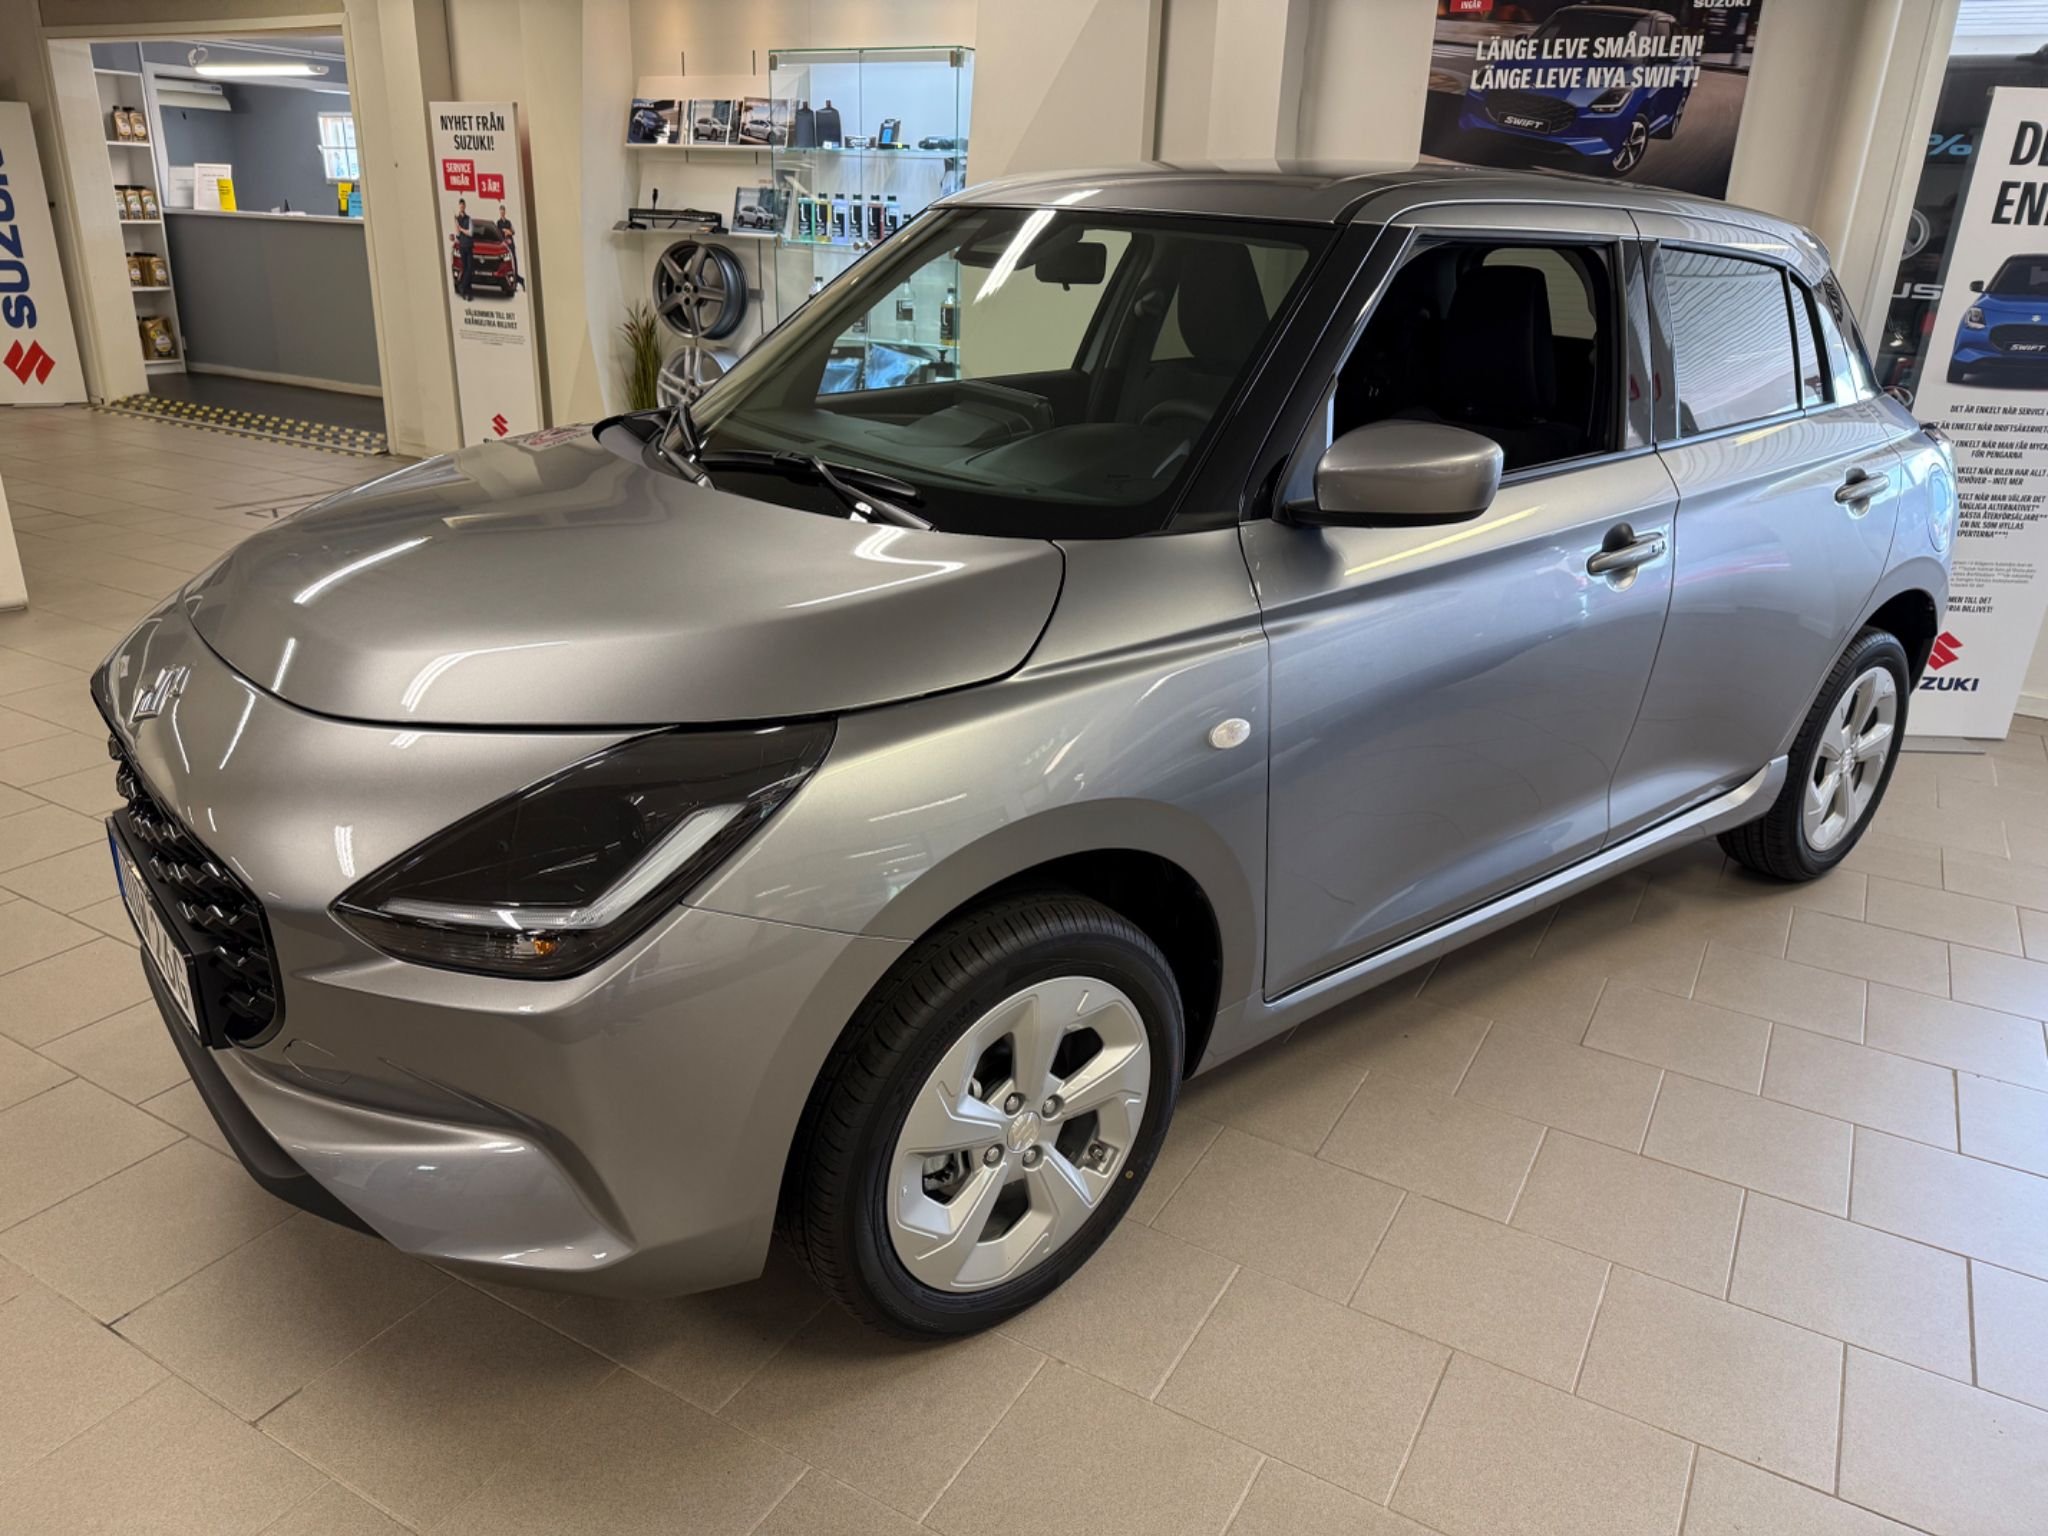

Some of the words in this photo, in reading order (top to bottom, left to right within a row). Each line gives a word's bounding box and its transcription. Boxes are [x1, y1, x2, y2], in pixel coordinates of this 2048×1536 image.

[1476, 36, 1538, 61] LÄNGE
[1542, 37, 1590, 60] LEVE
[1593, 31, 1704, 59] SMÅBILEN!
[1470, 65, 1533, 90] LÄNGE
[1535, 66, 1583, 89] LEVE
[1586, 66, 1626, 89] NYA
[1631, 65, 1701, 88] SWIFT!
[440, 114, 473, 131] NYHET
[475, 111, 505, 131] FRÅN
[1504, 115, 1544, 129] SWIFT
[453, 134, 495, 151] SUZUKI!
[445, 162, 472, 173] SERVICE
[481, 181, 487, 192] 3
[2009, 343, 2047, 352] SWIFT
[1950, 404, 1965, 413] DET
[1964, 403, 1975, 414] ÄR
[1975, 405, 2001, 414] ENKELT
[2001, 405, 2018, 415] NÄR
[2018, 406, 2045, 416] SERVICE
[1951, 422, 1977, 431] ENKELT
[1978, 422, 1993, 431] NÄR
[1993, 423, 2048, 434] DRIFTSÄKERHET
[1955, 439, 1981, 448] ENKELT
[1981, 440, 1997, 449] NÄR
[1997, 441, 2014, 450] MAN
[1971, 450, 1985, 459] FÖR
[1985, 450, 2023, 460] PENGARNA
[1978, 465, 1994, 476] NÄR
[1994, 467, 2014, 477] BILEN
[1919, 676, 1980, 692] ZUKI
